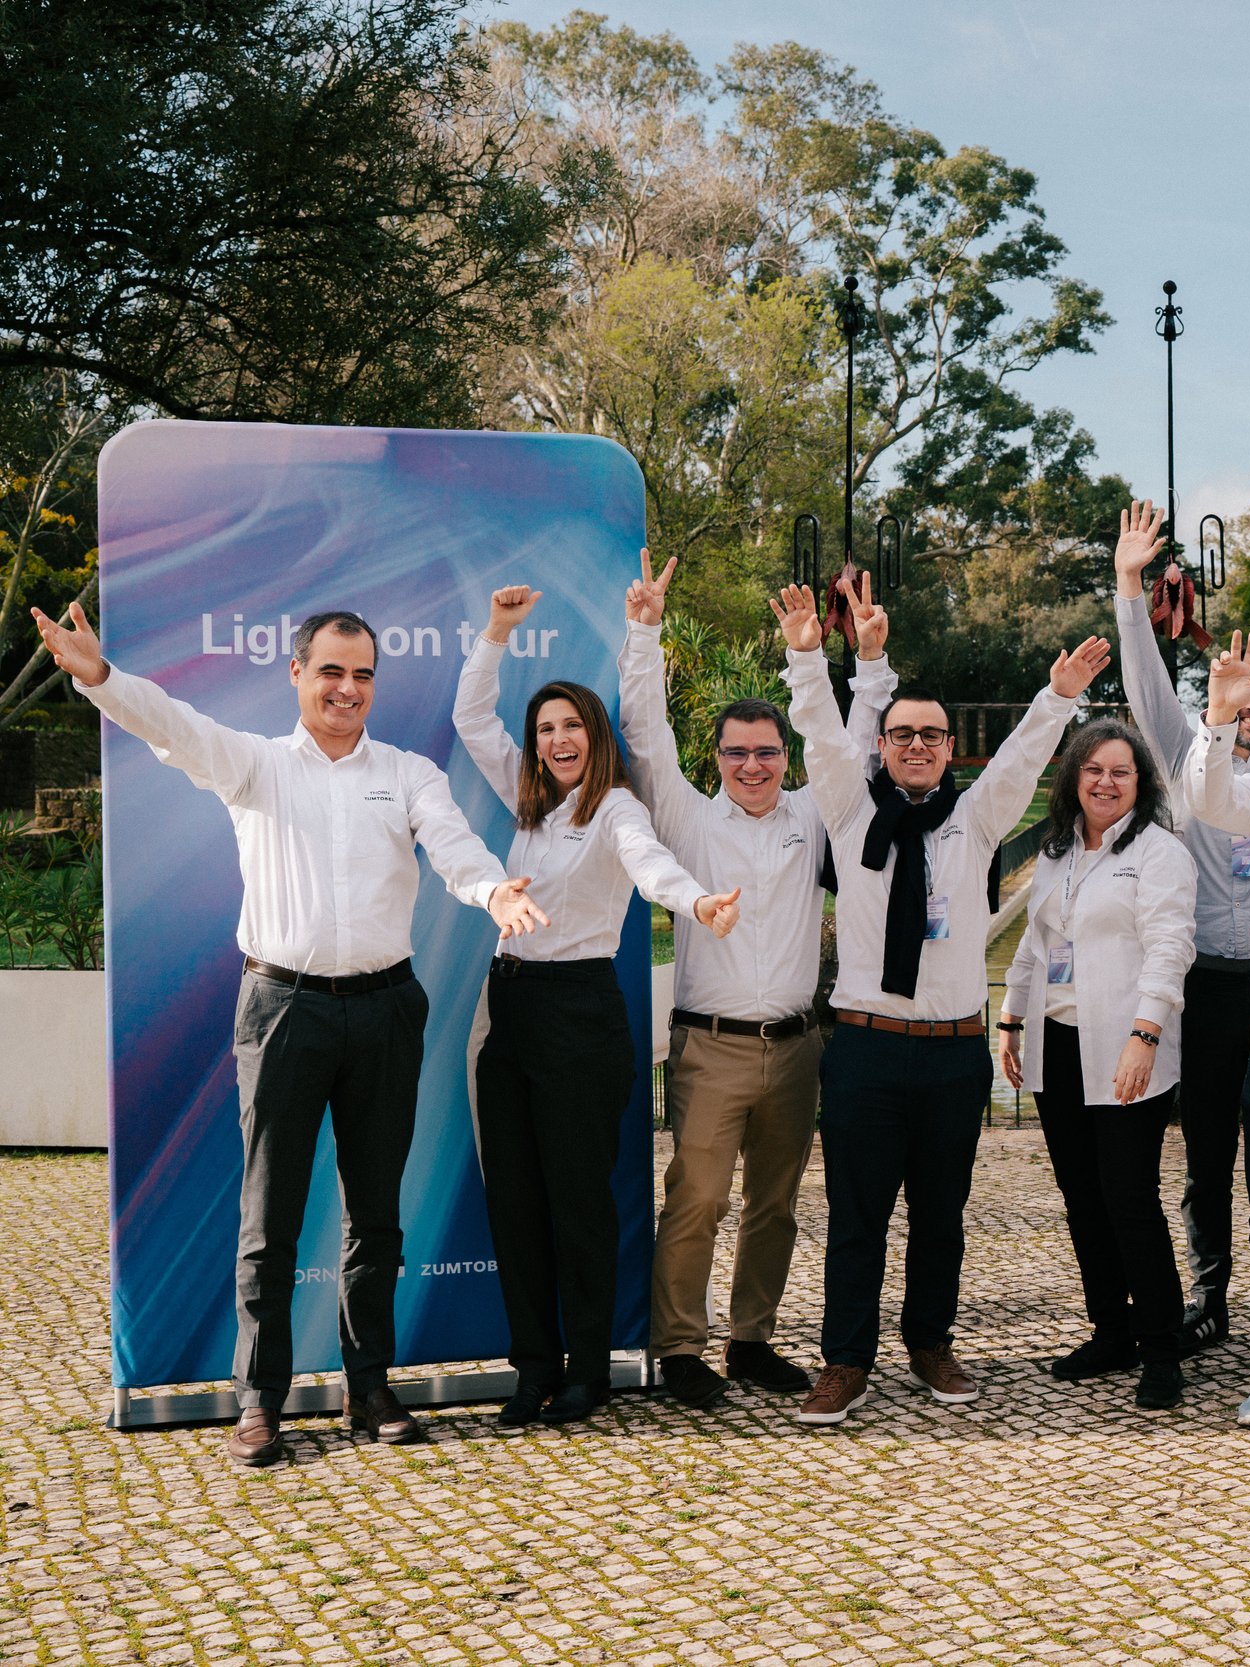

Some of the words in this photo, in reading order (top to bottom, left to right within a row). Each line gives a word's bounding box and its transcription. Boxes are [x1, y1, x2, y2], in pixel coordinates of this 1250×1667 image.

[380, 625, 442, 657] on
[456, 620, 559, 658] tur
[294, 1267, 338, 1284] ORN
[420, 1259, 499, 1277] ZUMTOB
